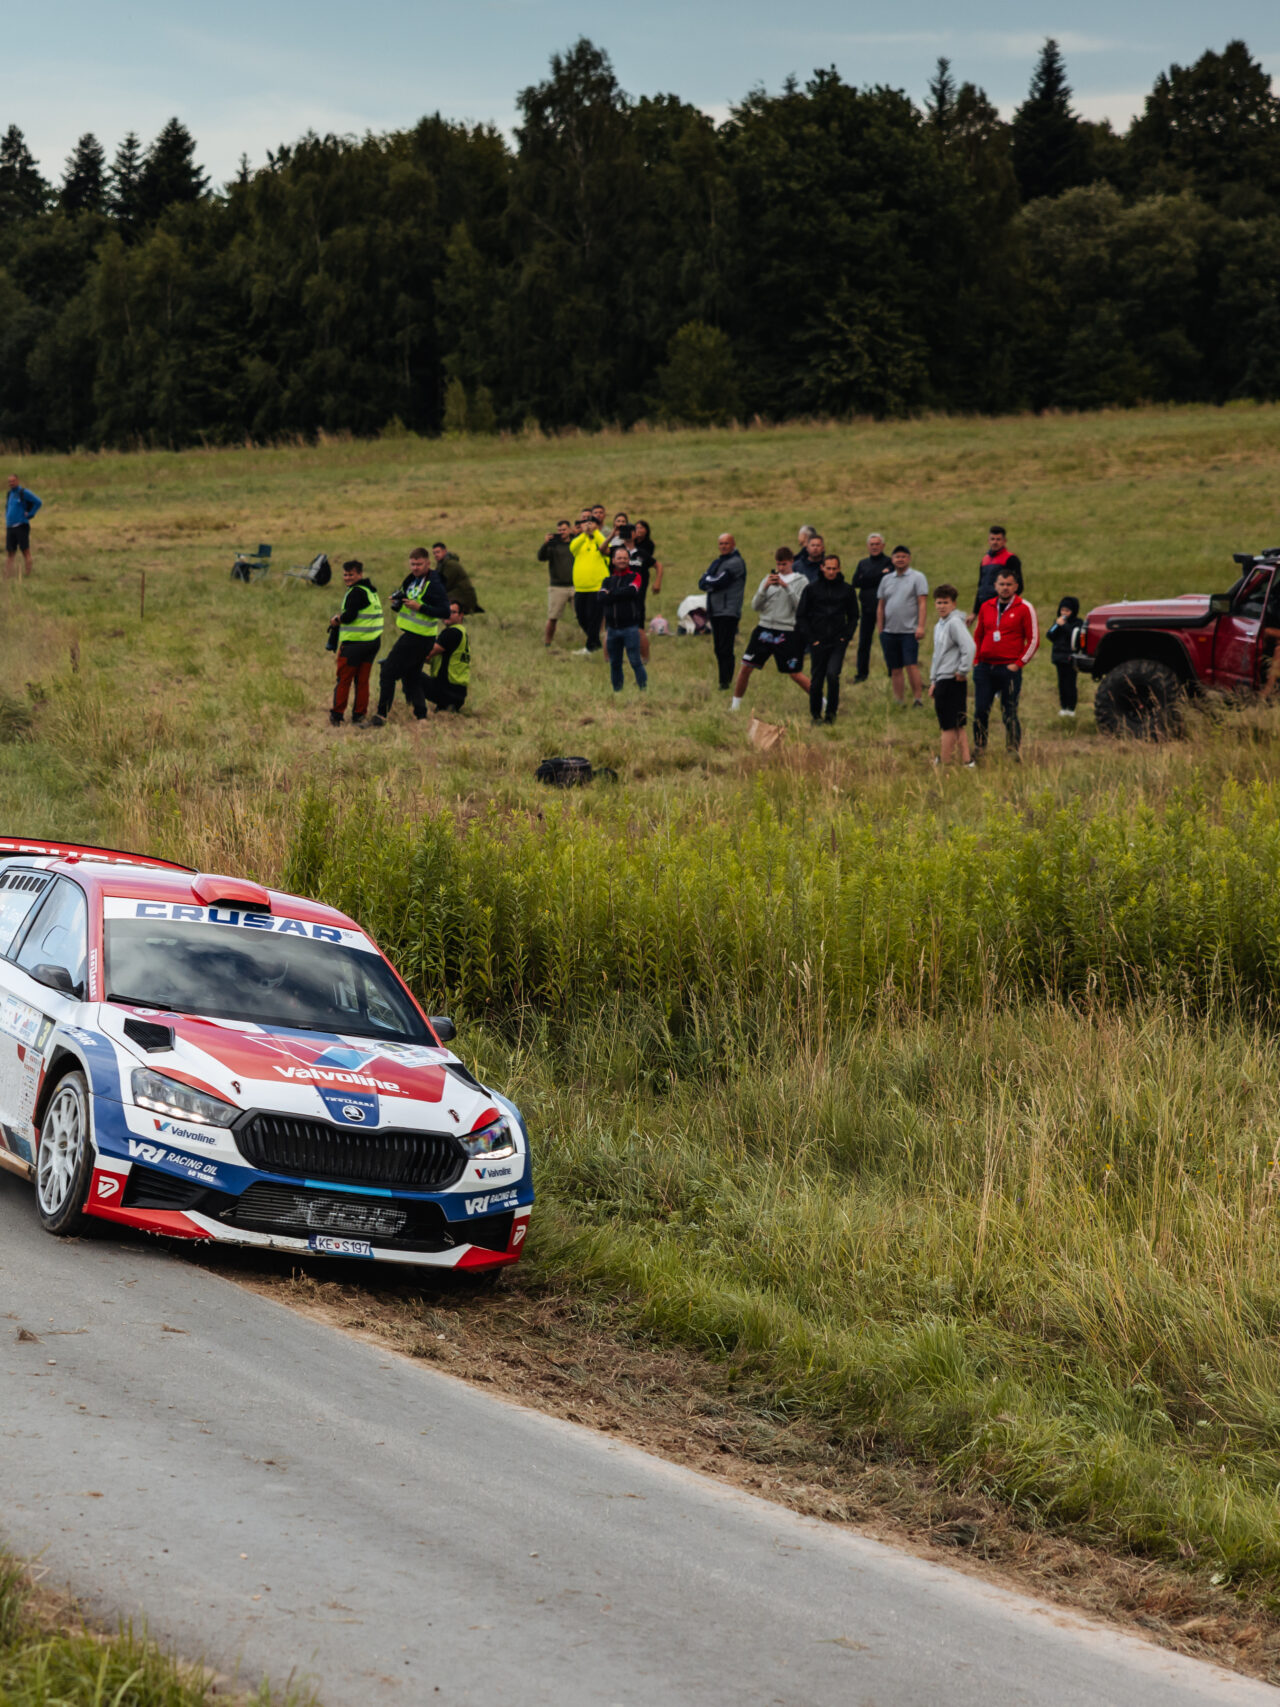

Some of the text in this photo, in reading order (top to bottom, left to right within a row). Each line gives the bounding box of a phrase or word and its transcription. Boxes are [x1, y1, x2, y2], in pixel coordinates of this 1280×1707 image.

[136, 903, 343, 943] CRUSAR
[37, 1021, 52, 1048] 3
[272, 1065, 400, 1093] Valvoline
[171, 1126, 216, 1145] Valvoline
[166, 1152, 203, 1170] RACING
[203, 1164, 218, 1176] OIL
[487, 1167, 512, 1178] Valvoline
[318, 1237, 369, 1254] KE S197
